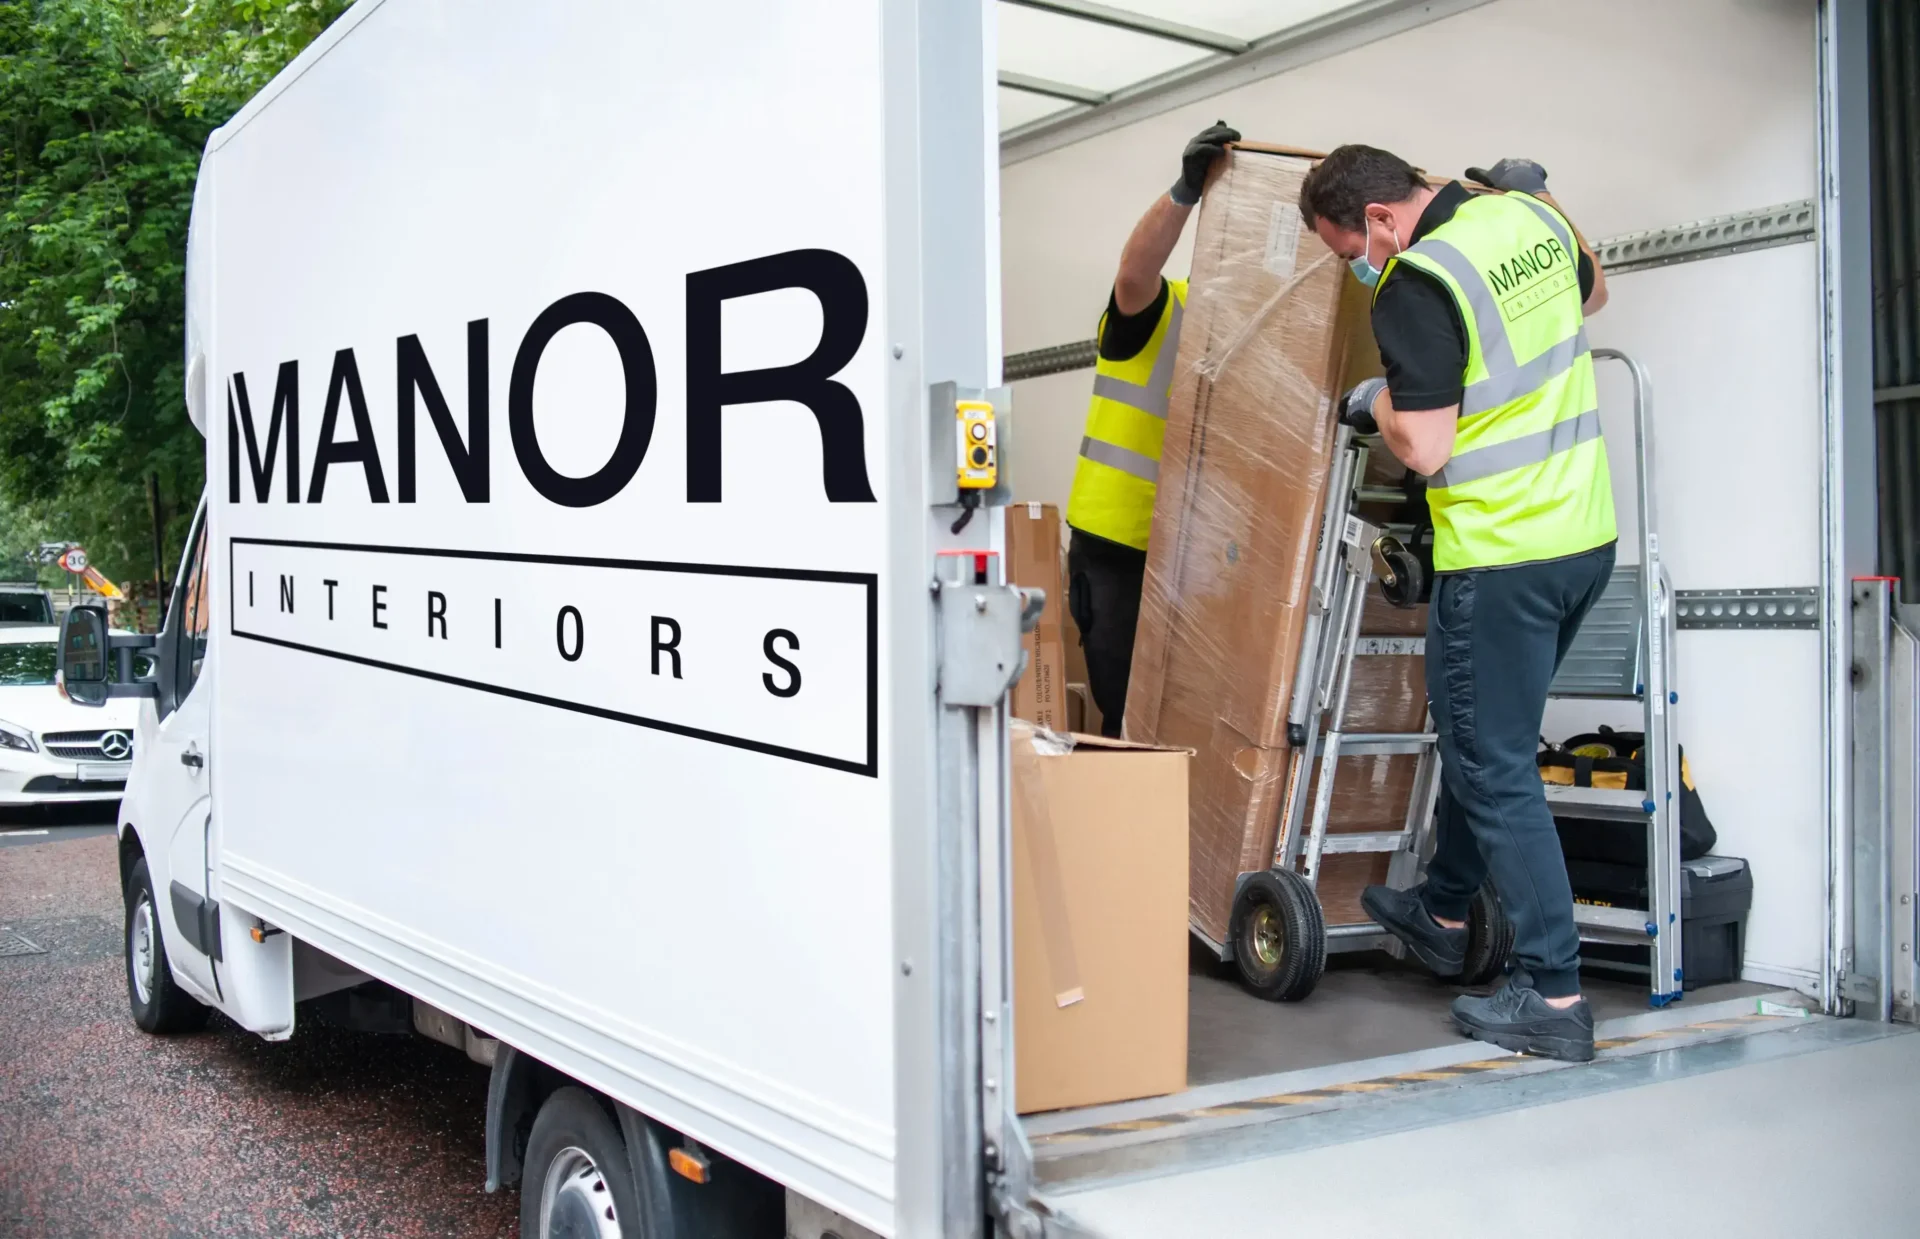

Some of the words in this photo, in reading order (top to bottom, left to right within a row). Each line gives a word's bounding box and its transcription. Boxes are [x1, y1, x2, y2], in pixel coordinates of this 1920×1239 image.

[1488, 238, 1569, 296] MANOR
[227, 248, 878, 508] MANOR
[68, 555, 87, 566] 30
[248, 571, 803, 699] INTERIORS
